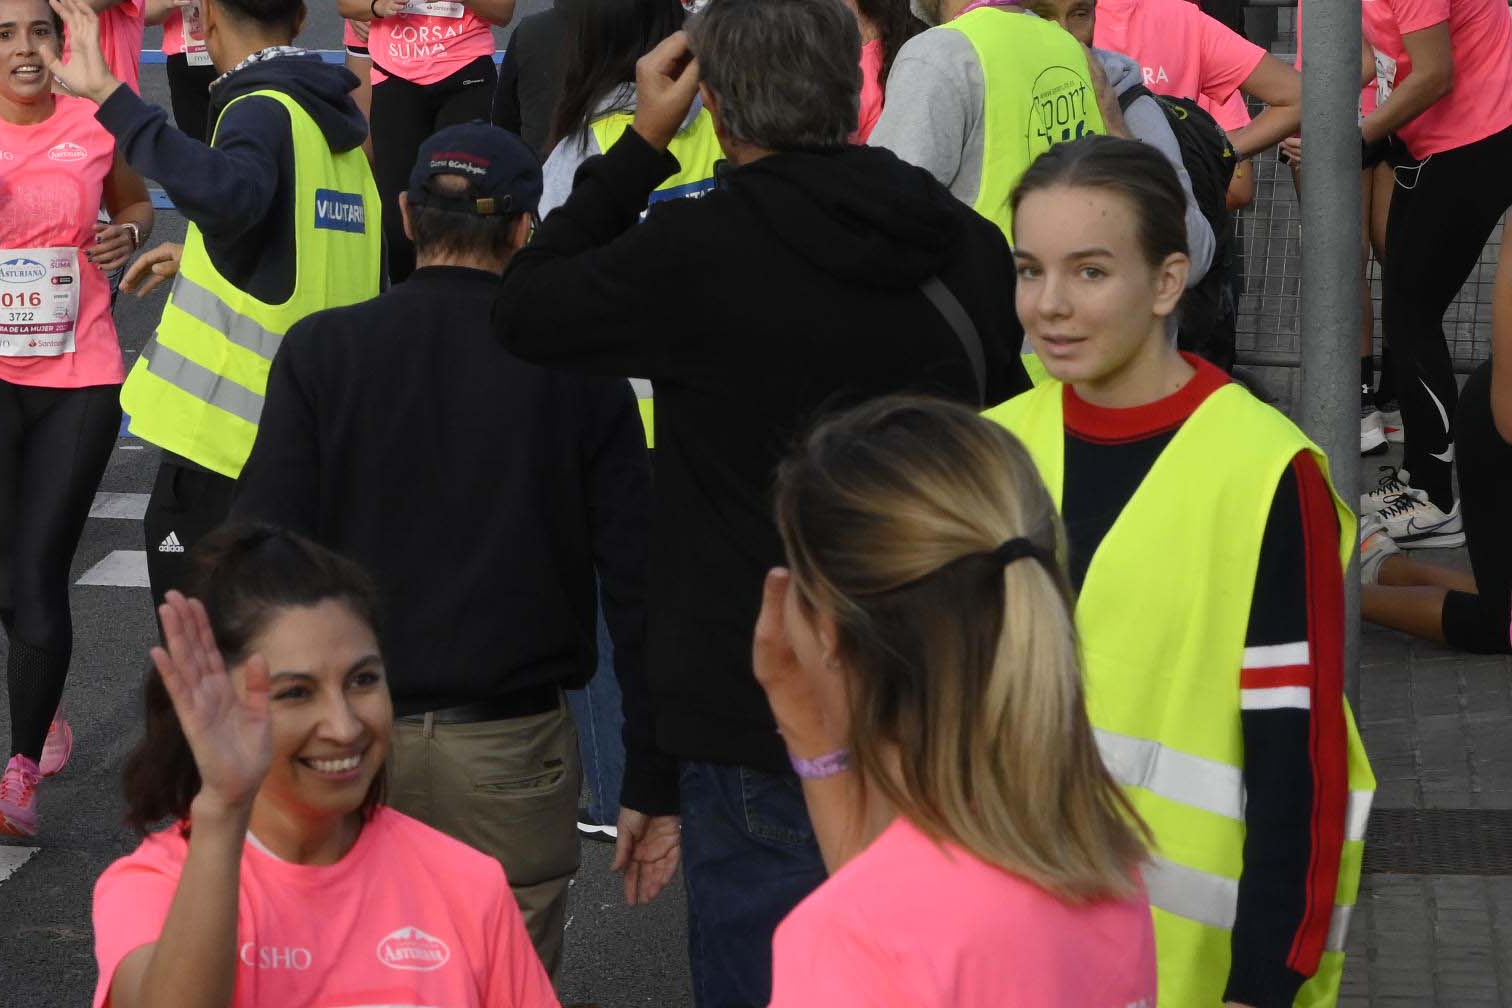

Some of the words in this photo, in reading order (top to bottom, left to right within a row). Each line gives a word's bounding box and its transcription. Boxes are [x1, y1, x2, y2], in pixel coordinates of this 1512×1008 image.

[50, 261, 71, 269] SUMA
[1, 292, 42, 307] 016
[9, 312, 34, 322] 3722
[9, 324, 19, 332] DE
[159, 544, 185, 553] adidas
